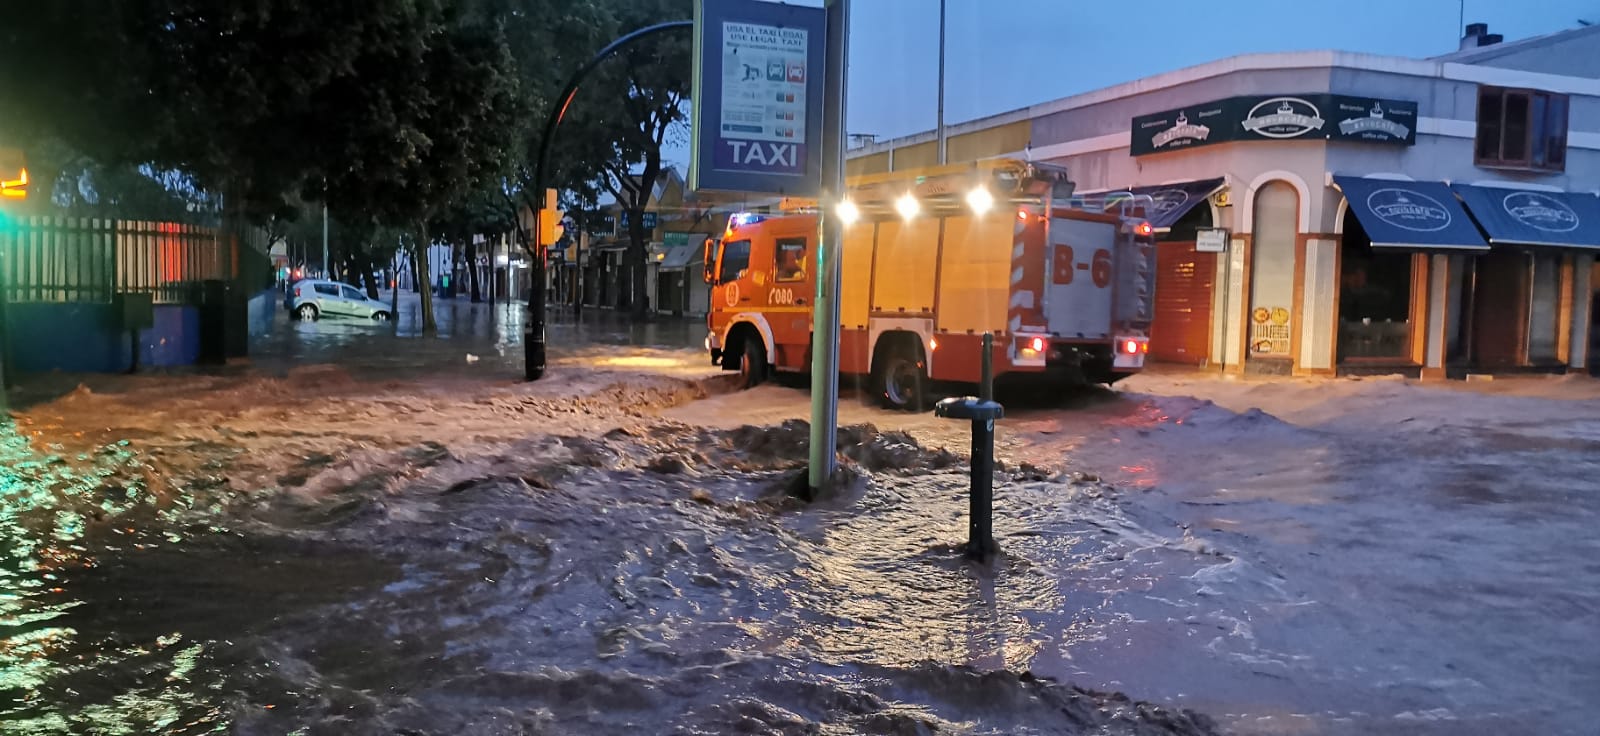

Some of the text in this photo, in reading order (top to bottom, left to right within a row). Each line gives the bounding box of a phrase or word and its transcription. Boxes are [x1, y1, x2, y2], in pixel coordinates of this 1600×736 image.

[726, 25, 804, 39] USA EL TAXI LEGAL
[730, 33, 747, 41] USE
[750, 35, 777, 44] LEGAL
[727, 141, 797, 167] TAXI
[1053, 243, 1112, 289] B-6
[775, 288, 793, 305] 080
